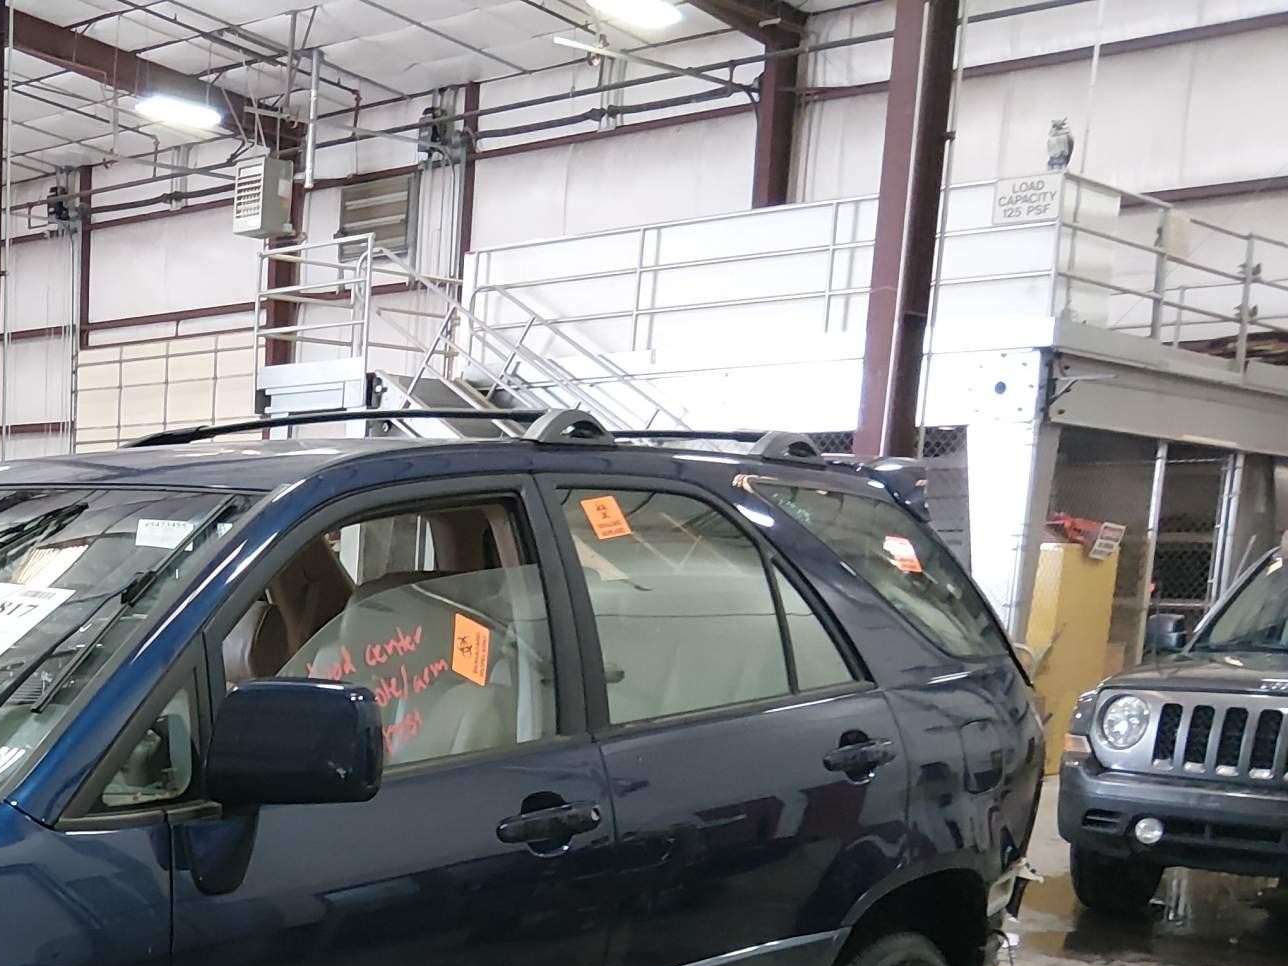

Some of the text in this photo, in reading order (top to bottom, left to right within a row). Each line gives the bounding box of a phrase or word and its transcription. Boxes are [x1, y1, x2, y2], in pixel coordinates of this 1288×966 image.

[1012, 180, 1045, 194] LOAD
[999, 191, 1056, 207] CAPACITY
[1003, 203, 1050, 218] 125 PSF
